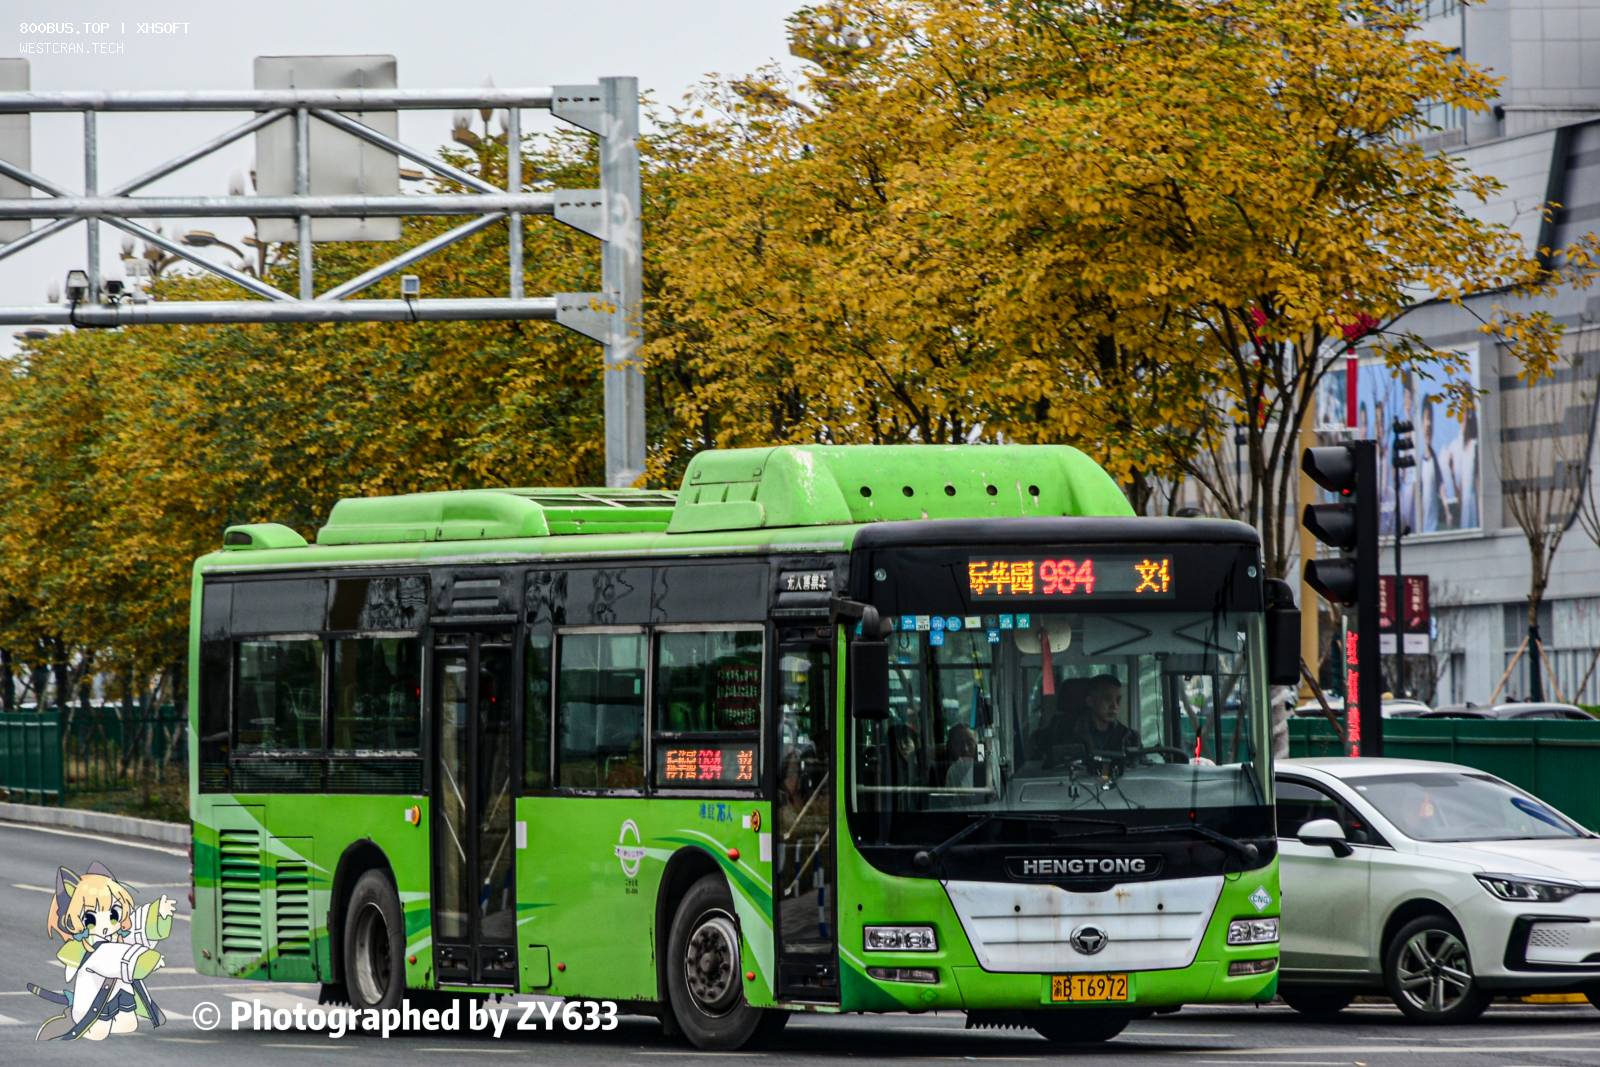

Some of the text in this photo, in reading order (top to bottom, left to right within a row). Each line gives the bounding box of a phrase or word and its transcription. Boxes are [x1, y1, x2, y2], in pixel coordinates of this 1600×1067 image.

[1040, 559, 1095, 594] 984
[1023, 858, 1146, 874] HENGTONG
[1252, 894, 1269, 905] CNG
